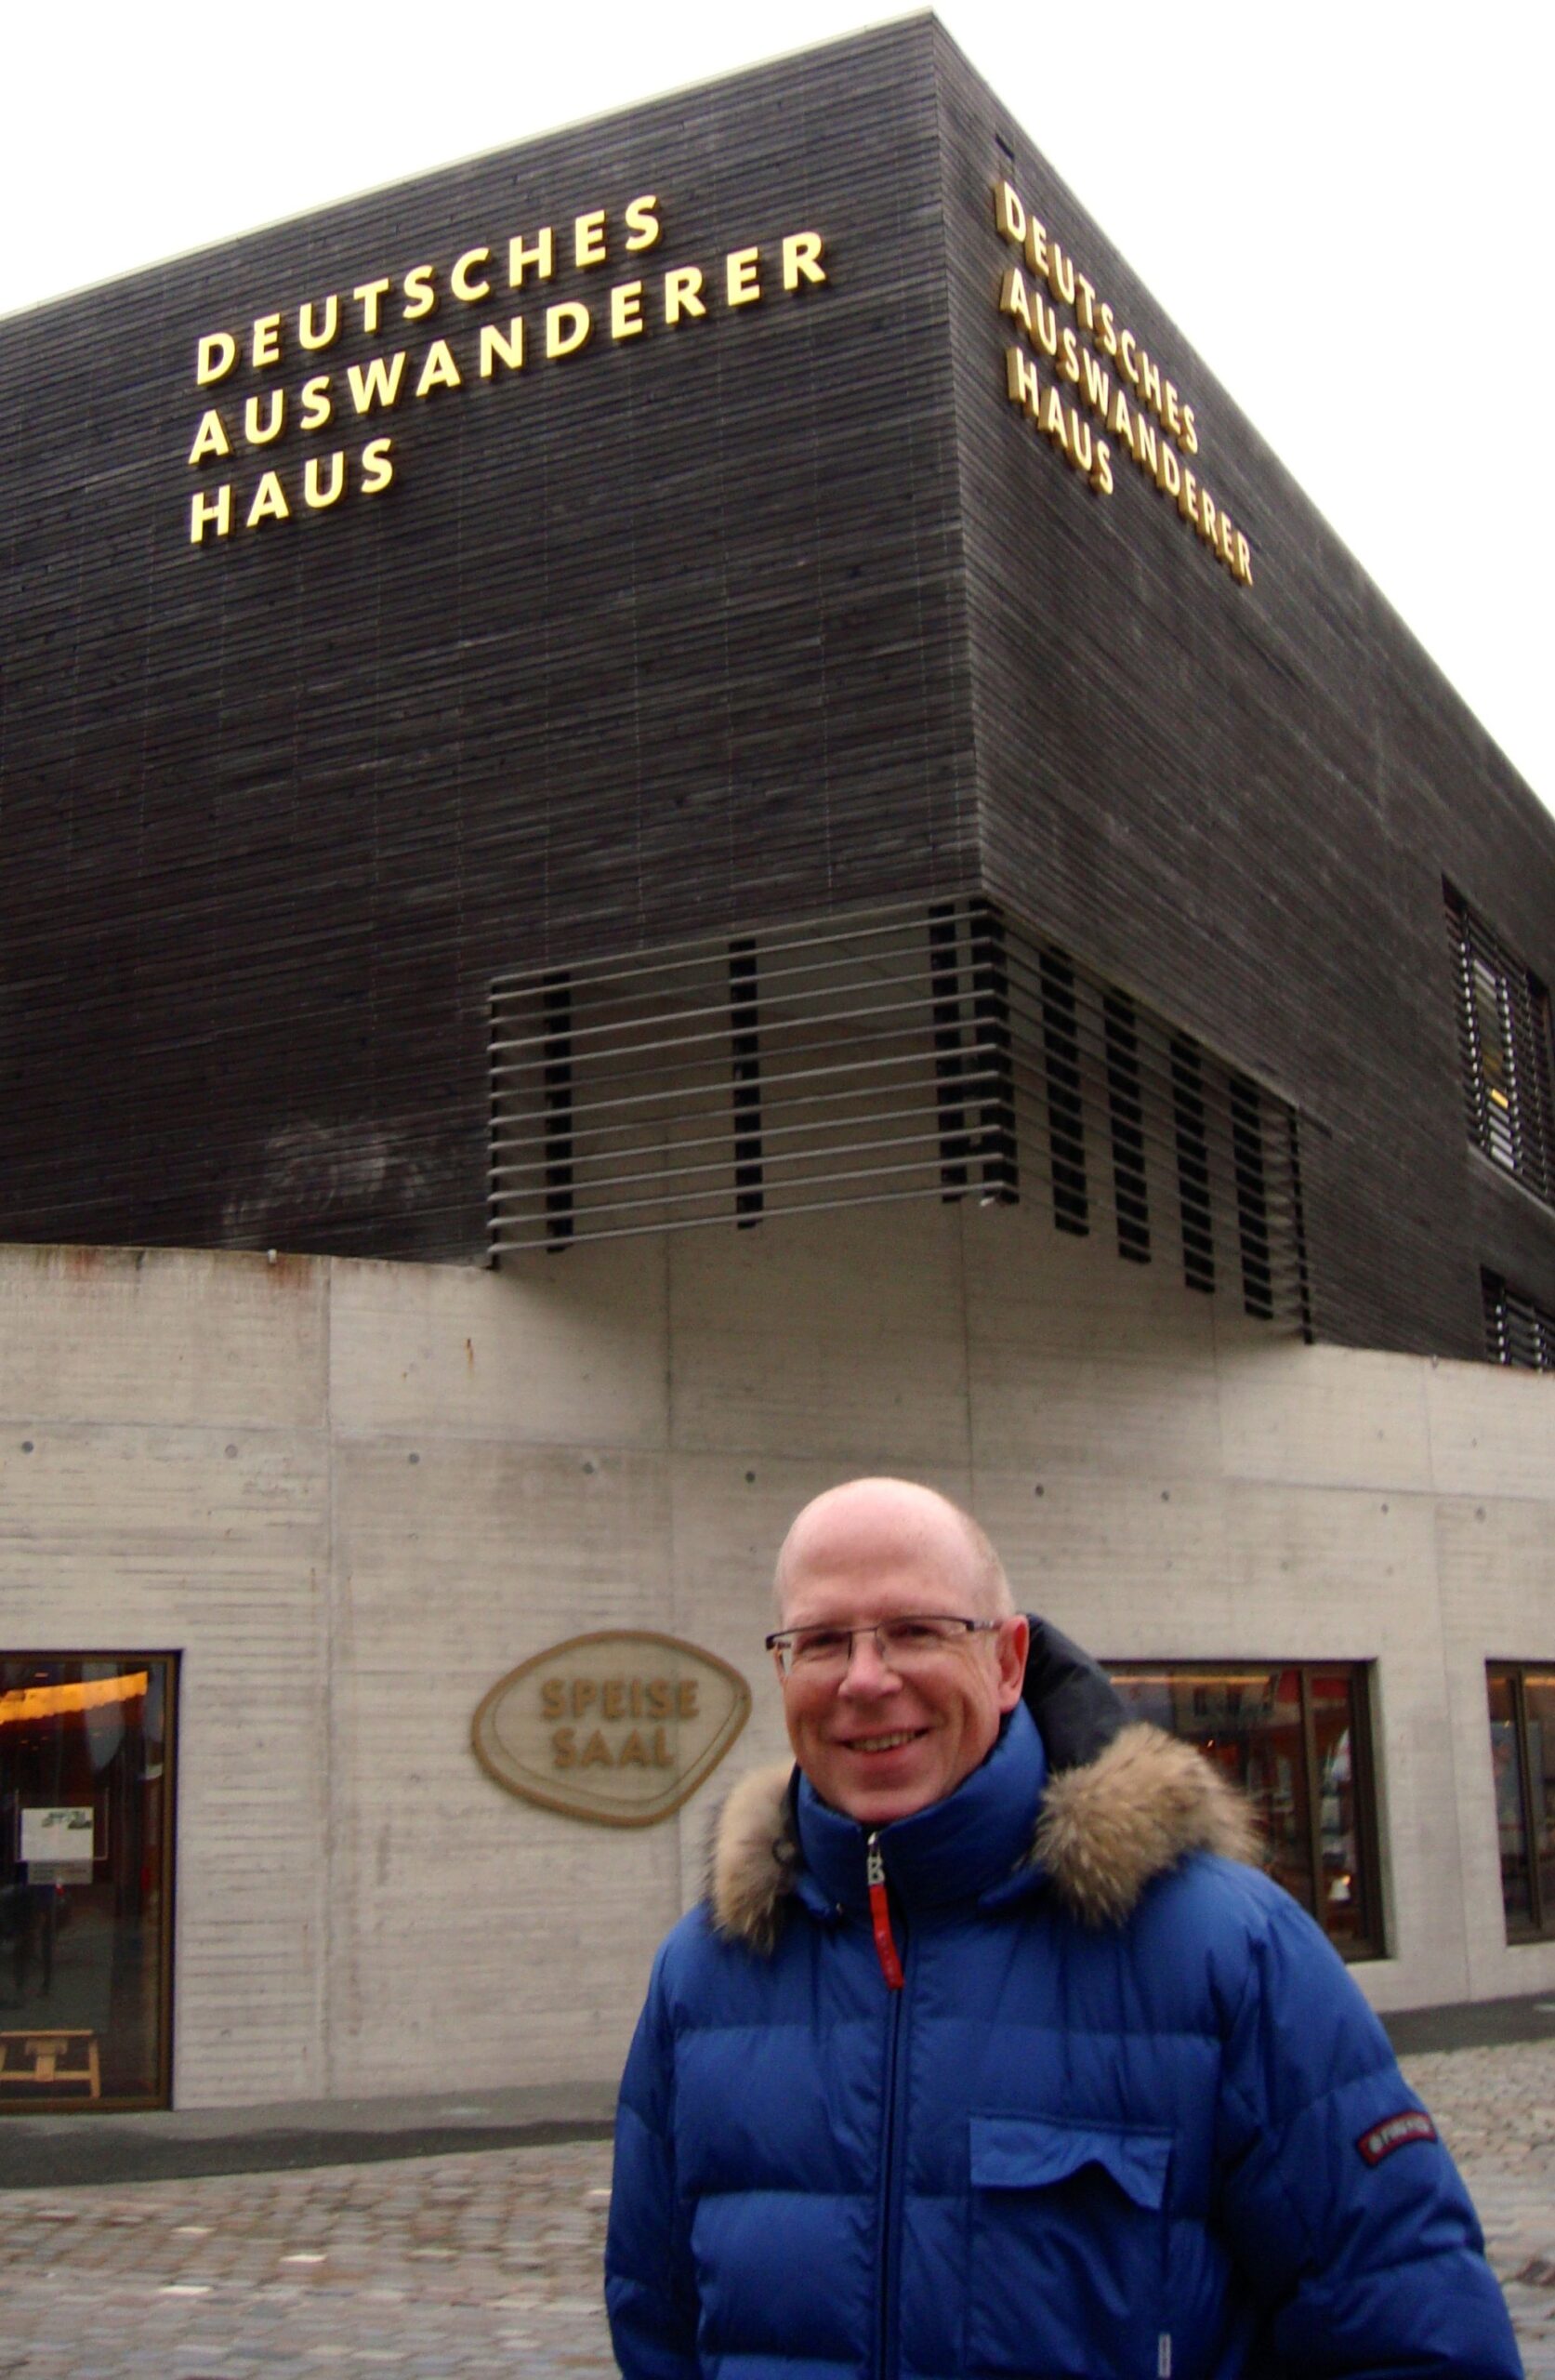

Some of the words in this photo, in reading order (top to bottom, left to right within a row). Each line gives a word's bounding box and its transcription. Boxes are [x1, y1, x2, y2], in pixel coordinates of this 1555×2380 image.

[188, 231, 826, 464] AUSWANDERER
[196, 195, 660, 385] DEUTSCHES
[995, 180, 1198, 455] DEUTSCHES
[190, 438, 393, 543] HAUS
[1000, 267, 1253, 587] AUSWANDERER
[1007, 346, 1114, 495] HAUS
[540, 1677, 700, 1720] SPEISE
[553, 1726, 675, 1767] SAAL
